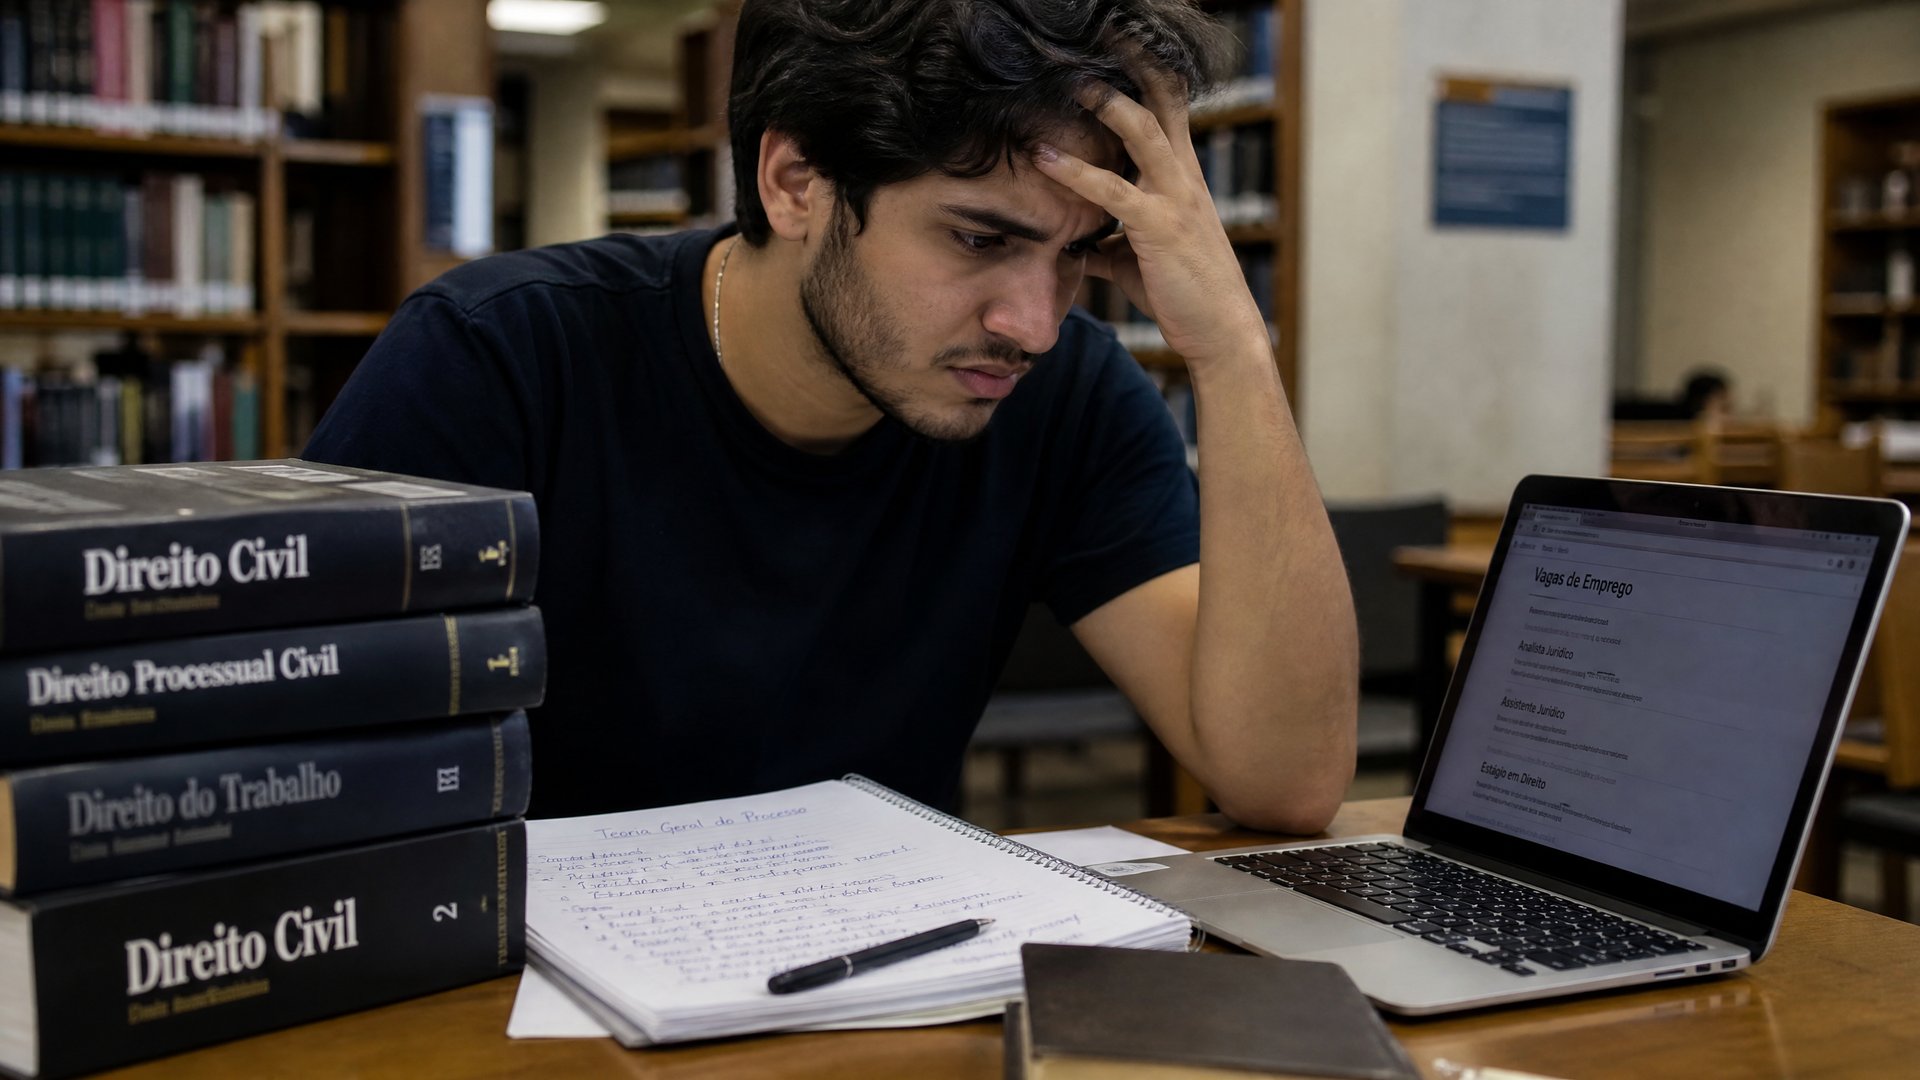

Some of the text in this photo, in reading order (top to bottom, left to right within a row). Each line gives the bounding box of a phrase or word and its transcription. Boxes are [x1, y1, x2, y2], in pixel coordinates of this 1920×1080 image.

[83, 534, 309, 594] Direito Civil
[1534, 566, 1633, 599] Vagas de Emprego
[1518, 639, 1545, 655] Analista
[27, 643, 339, 706] Direito Processual Civil
[1500, 695, 1537, 713] Assistente
[1507, 771, 1520, 783] em
[1520, 772, 1547, 790] Direito
[67, 761, 342, 836] Direito do Trabalho
[594, 806, 807, 841] Teoria Geral do Processo
[432, 902, 459, 922] 2
[125, 897, 359, 996] Direito Civil
